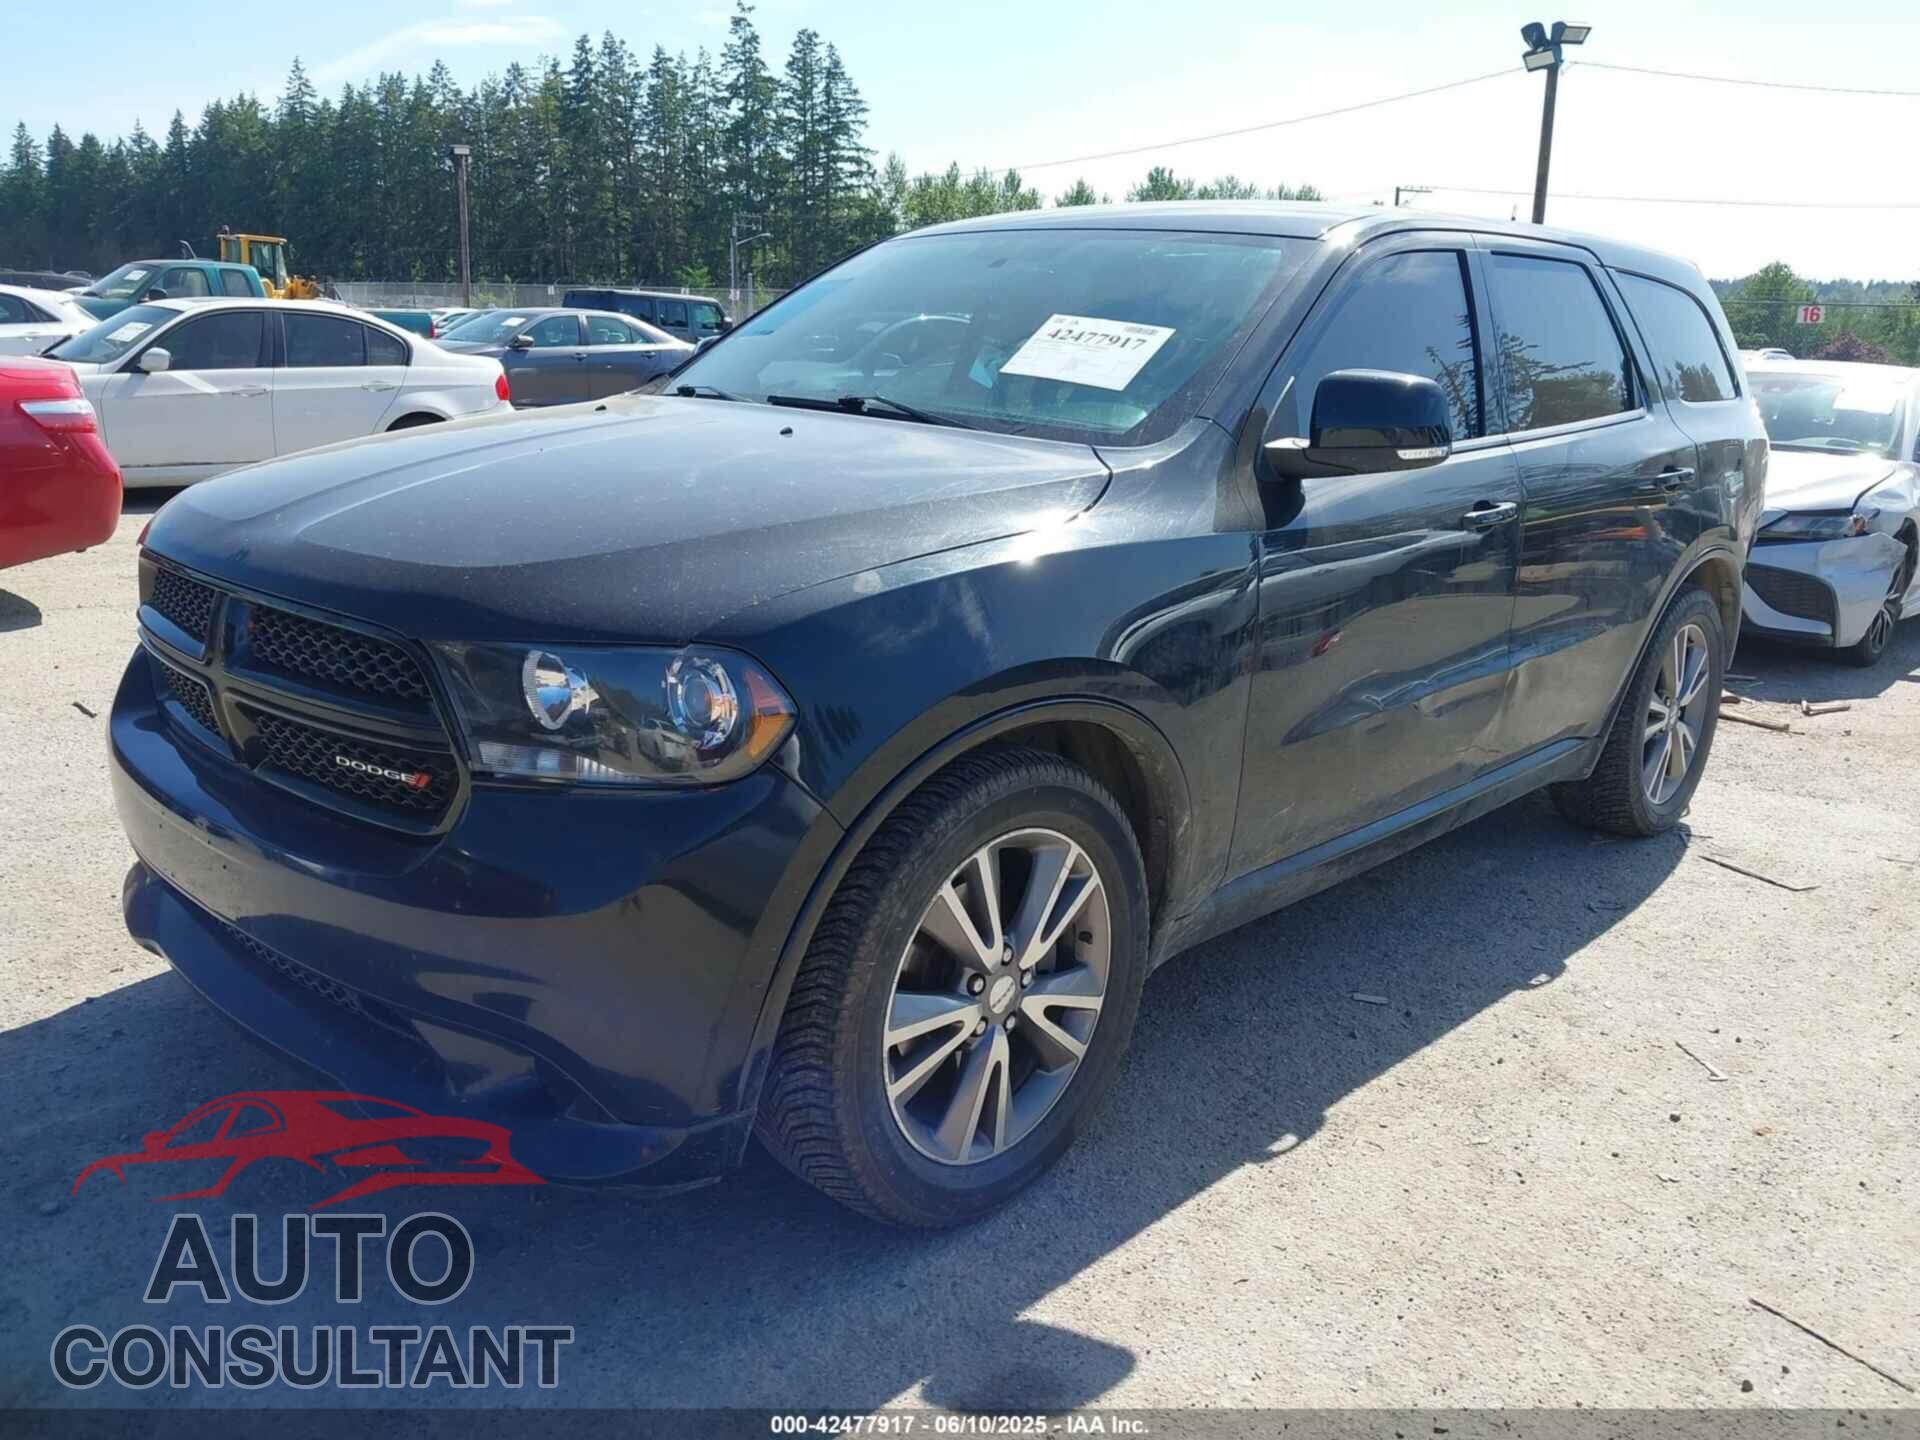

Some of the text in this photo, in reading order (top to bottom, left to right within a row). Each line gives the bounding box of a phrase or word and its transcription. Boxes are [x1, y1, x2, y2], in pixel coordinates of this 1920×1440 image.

[1802, 306, 1821, 322] 16
[1048, 327, 1147, 350] 42477917
[335, 755, 417, 785] DODGE
